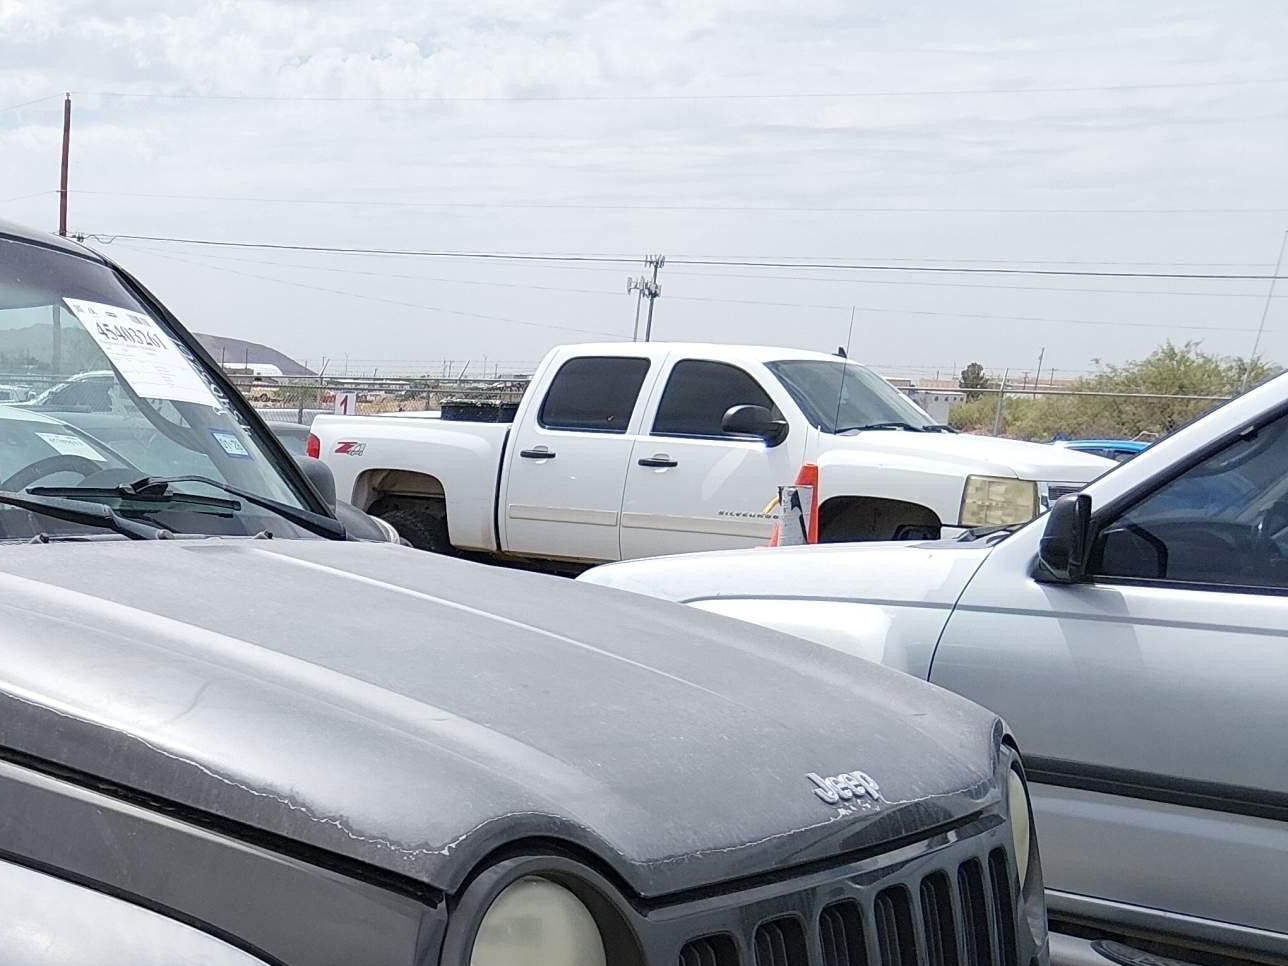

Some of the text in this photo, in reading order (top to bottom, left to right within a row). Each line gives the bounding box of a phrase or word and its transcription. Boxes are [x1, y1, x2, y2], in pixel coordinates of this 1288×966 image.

[96, 322, 168, 350] 45403261
[339, 394, 349, 415] 1
[718, 510, 780, 520] SILVERADO
[806, 769, 880, 804] Jeep
